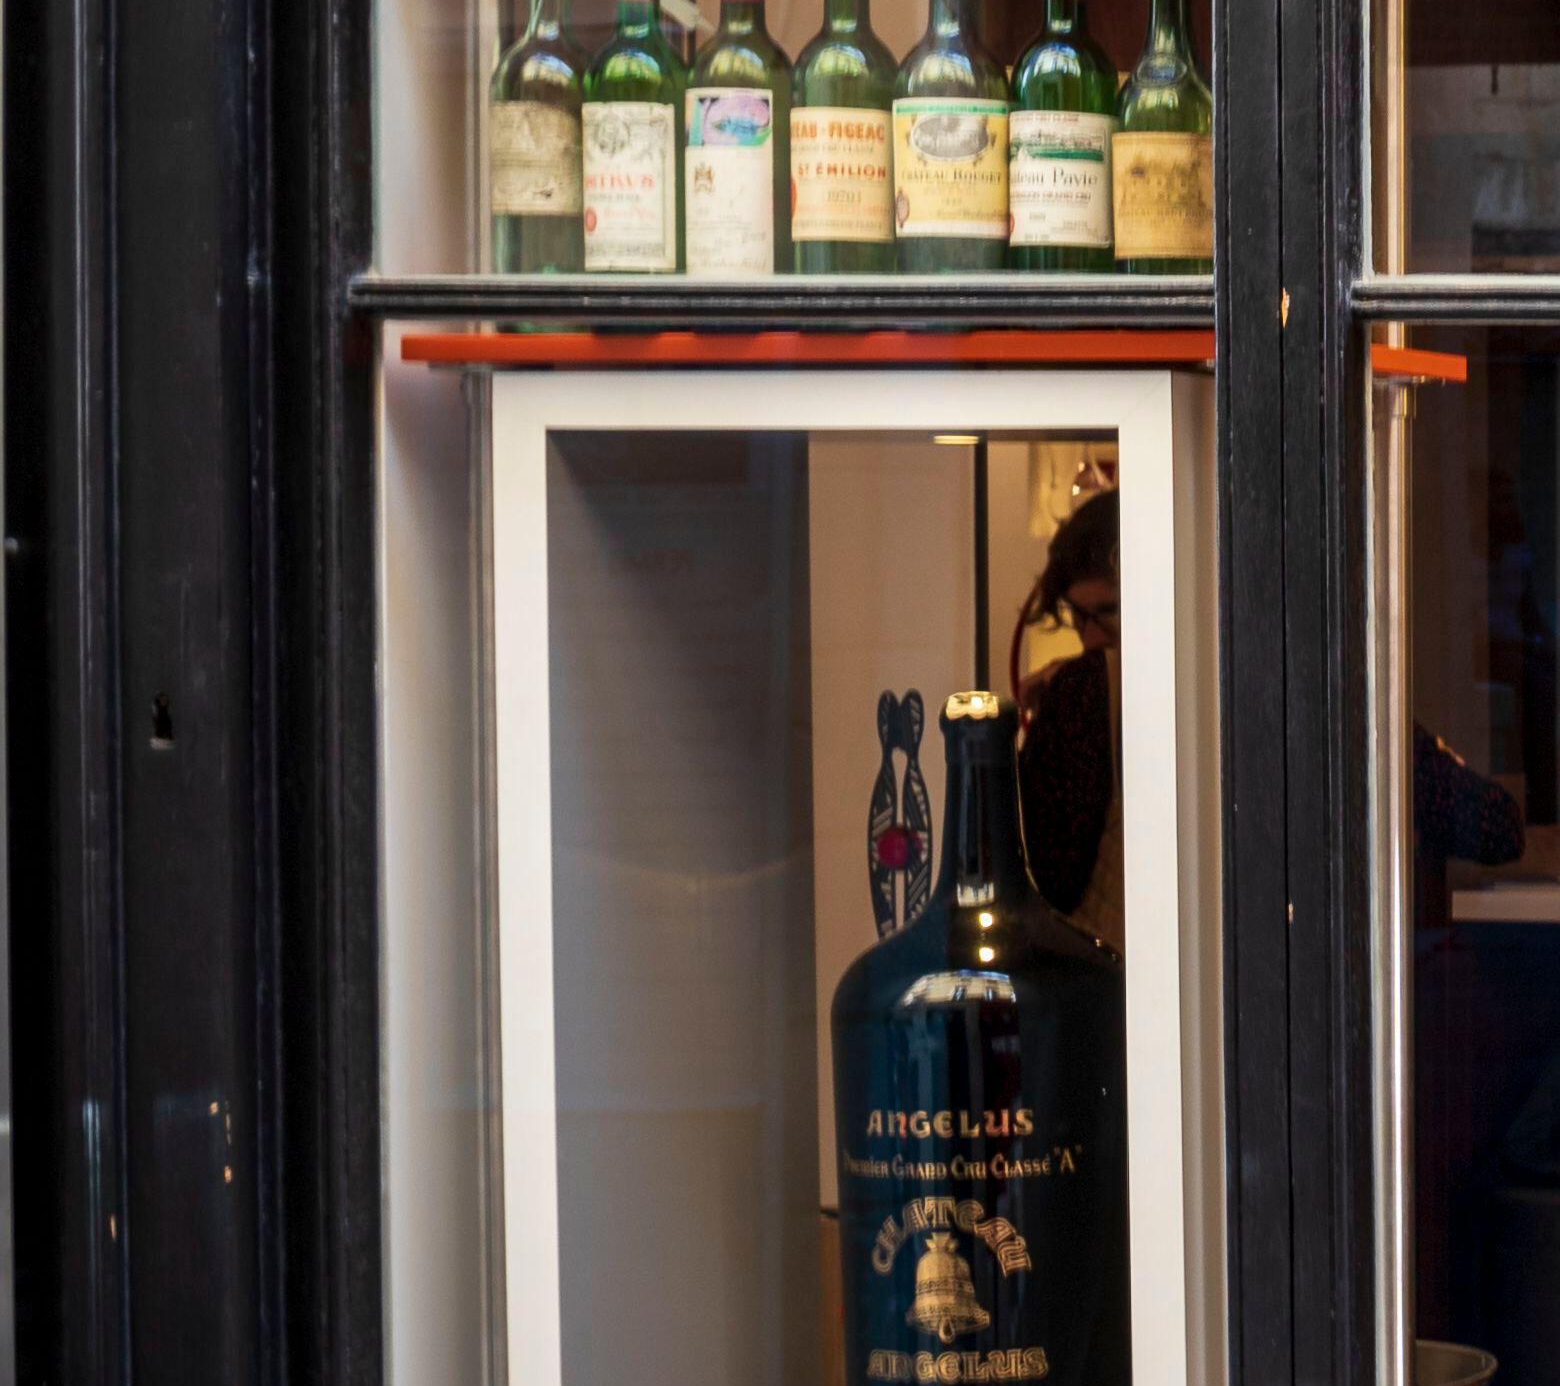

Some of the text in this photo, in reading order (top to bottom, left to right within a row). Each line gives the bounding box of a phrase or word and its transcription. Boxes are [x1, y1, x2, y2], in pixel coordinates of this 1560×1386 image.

[1053, 168, 1098, 187] Pavie
[867, 1108, 1034, 1139] ANGELUS
[871, 1196, 1033, 1277] CHATEAU
[866, 1346, 1049, 1385] ANGELUS
